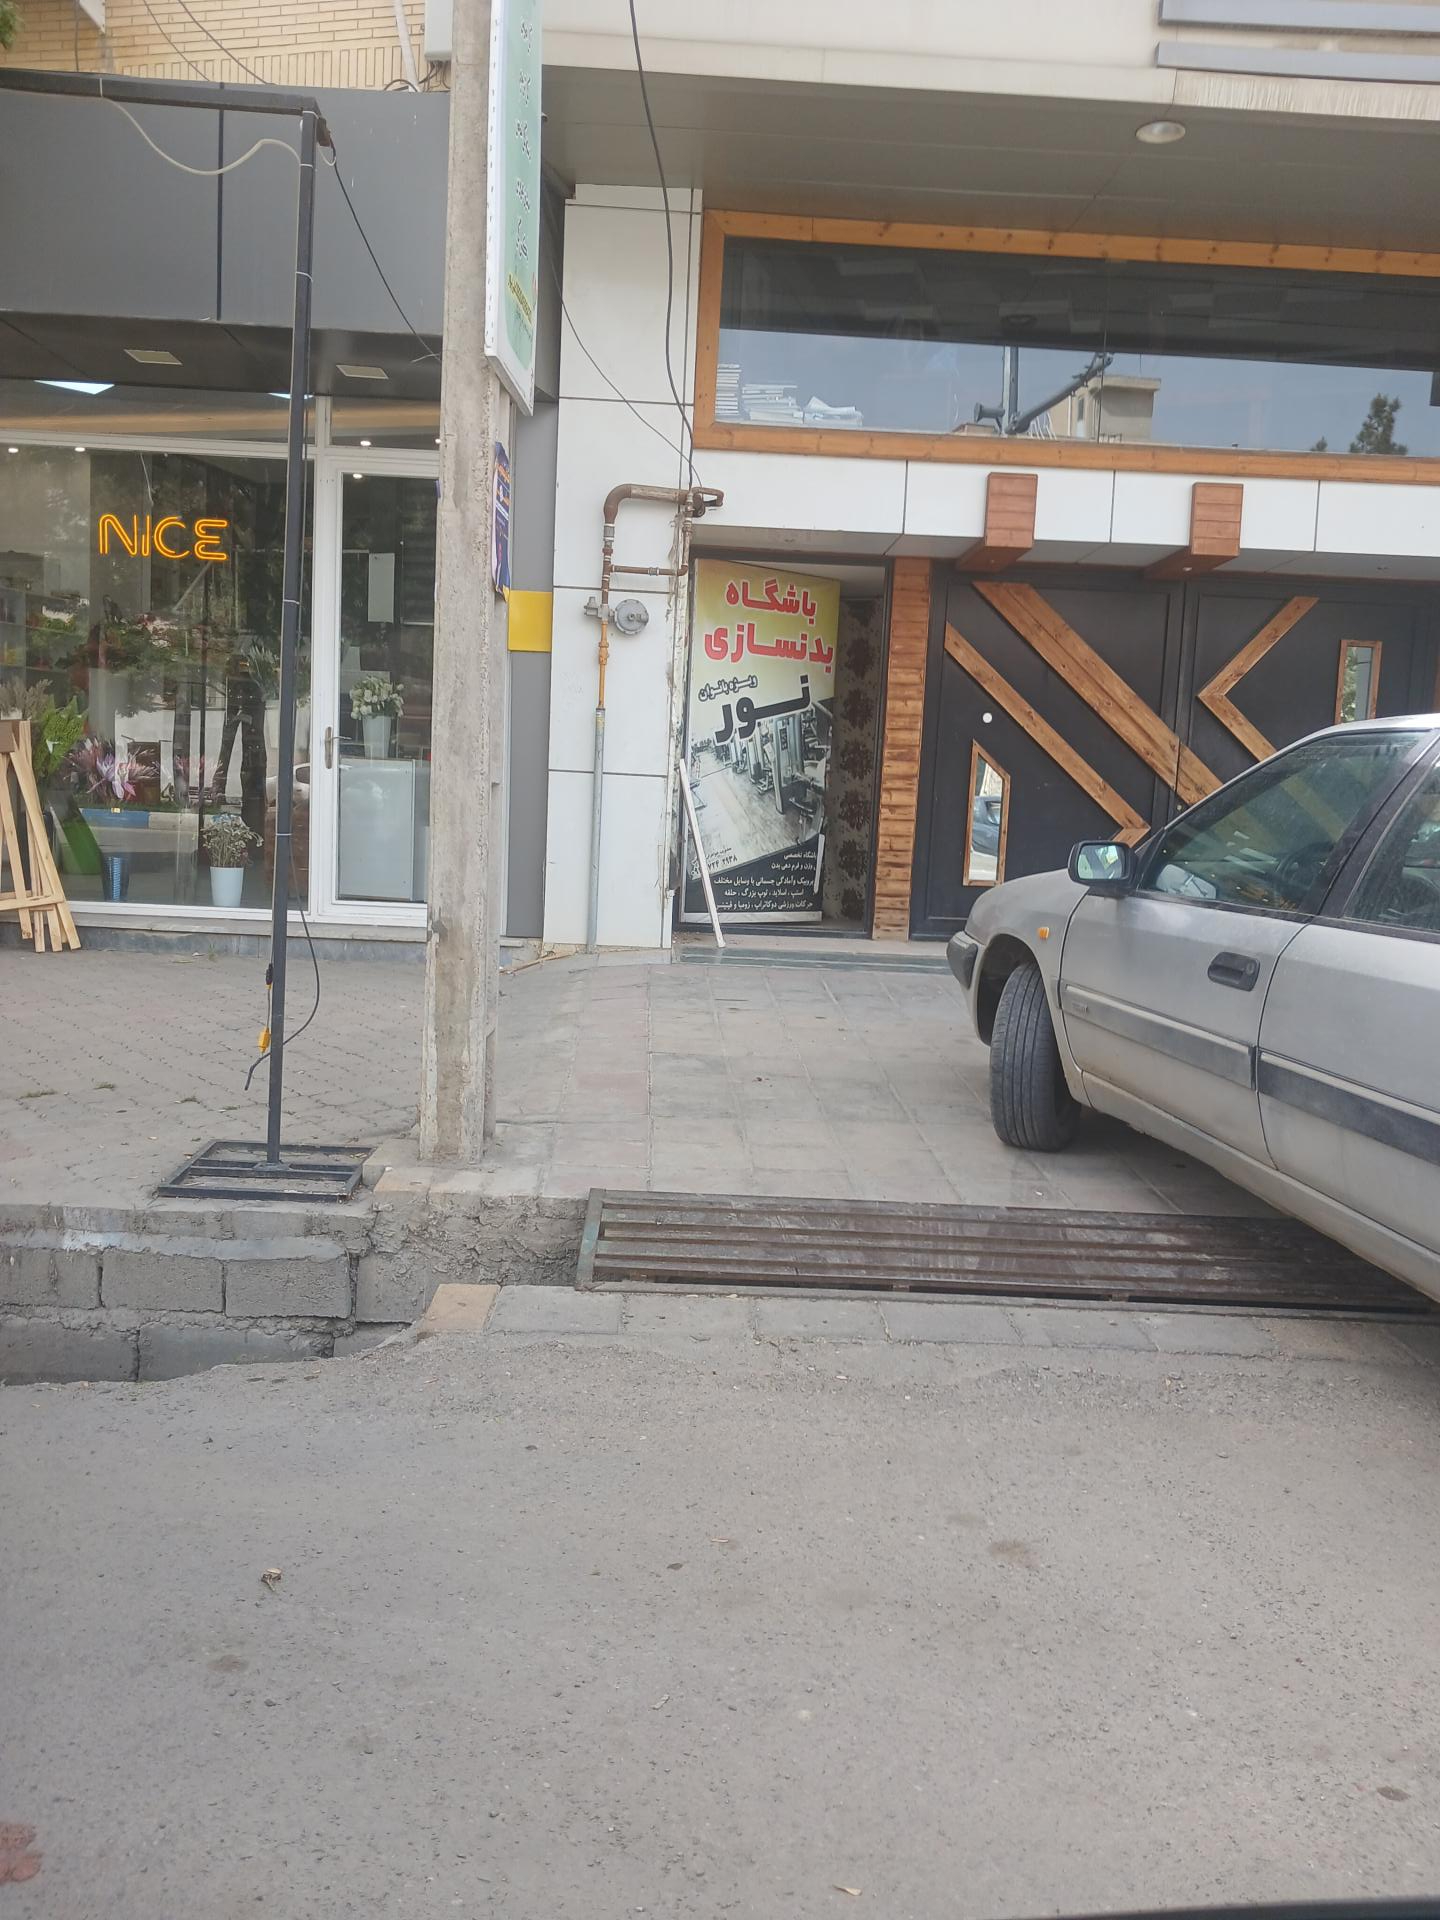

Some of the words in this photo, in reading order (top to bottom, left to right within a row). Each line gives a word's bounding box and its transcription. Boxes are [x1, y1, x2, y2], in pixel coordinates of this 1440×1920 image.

[99, 513, 229, 561] NICE
[726, 578, 817, 625] باشگاه
[703, 622, 834, 674] بدنسازی
[714, 674, 811, 744] نور
